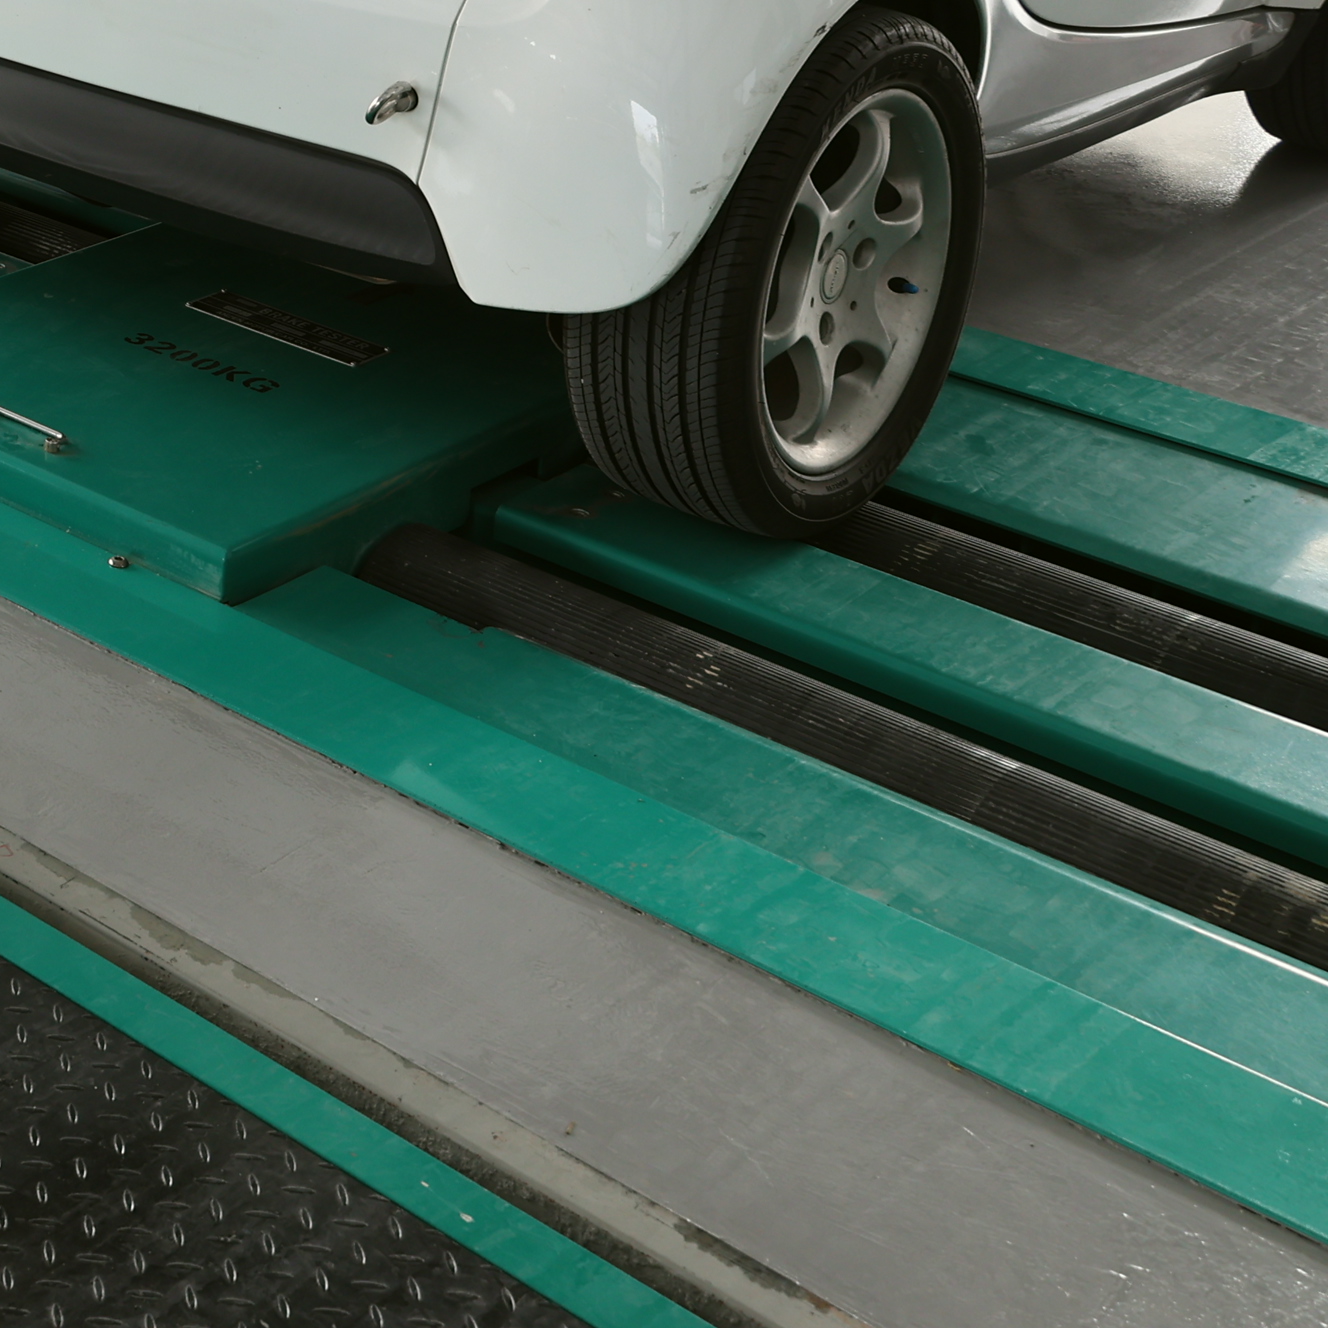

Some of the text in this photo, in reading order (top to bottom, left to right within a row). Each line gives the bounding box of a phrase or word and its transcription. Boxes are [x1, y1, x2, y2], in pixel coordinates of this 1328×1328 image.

[259, 308, 370, 350] BRAKE TESTER
[124, 332, 280, 393] 3200KG
